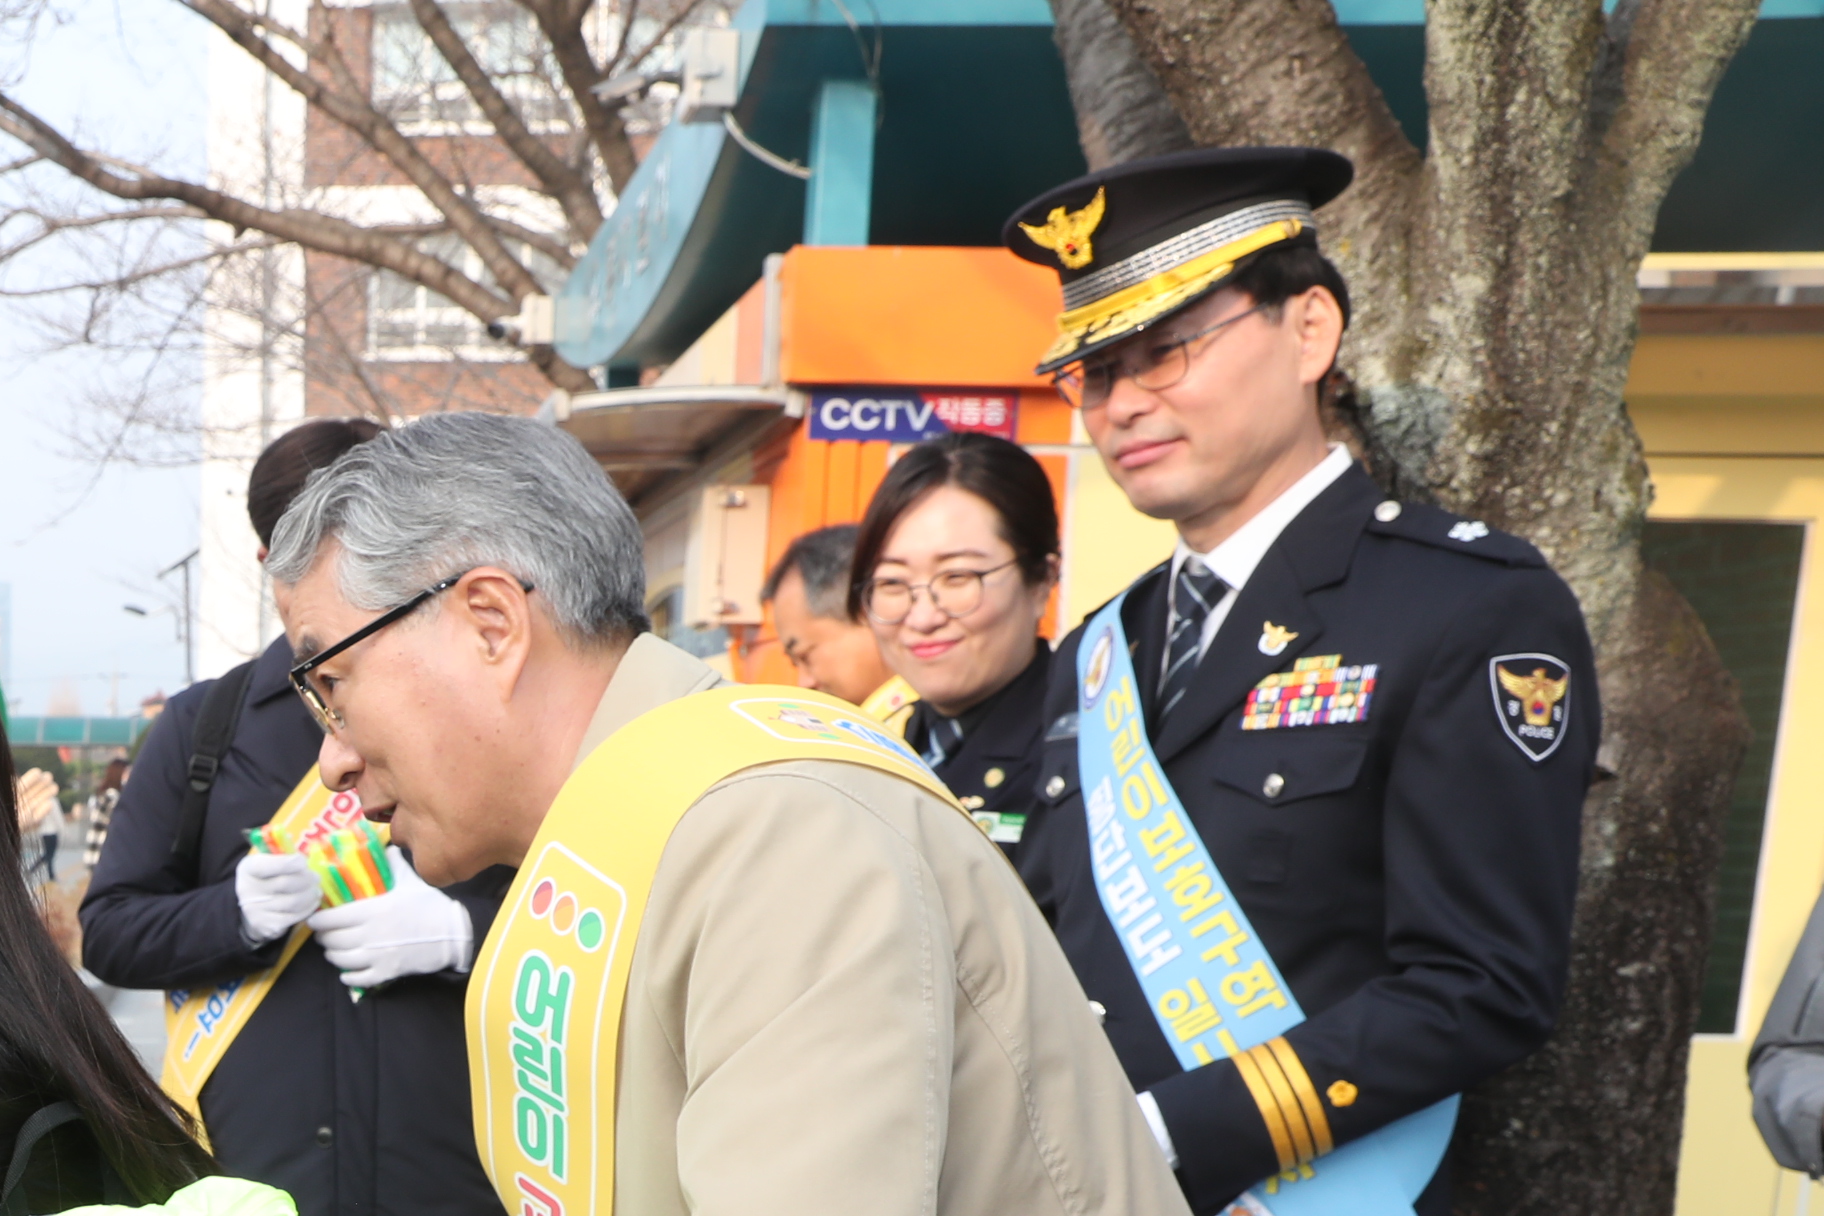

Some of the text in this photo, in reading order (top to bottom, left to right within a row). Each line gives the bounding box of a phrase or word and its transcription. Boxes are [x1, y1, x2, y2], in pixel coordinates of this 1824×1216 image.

[819, 396, 936, 432] CCTV
[1518, 723, 1555, 740] POLICE
[514, 954, 572, 1181] 어린이
